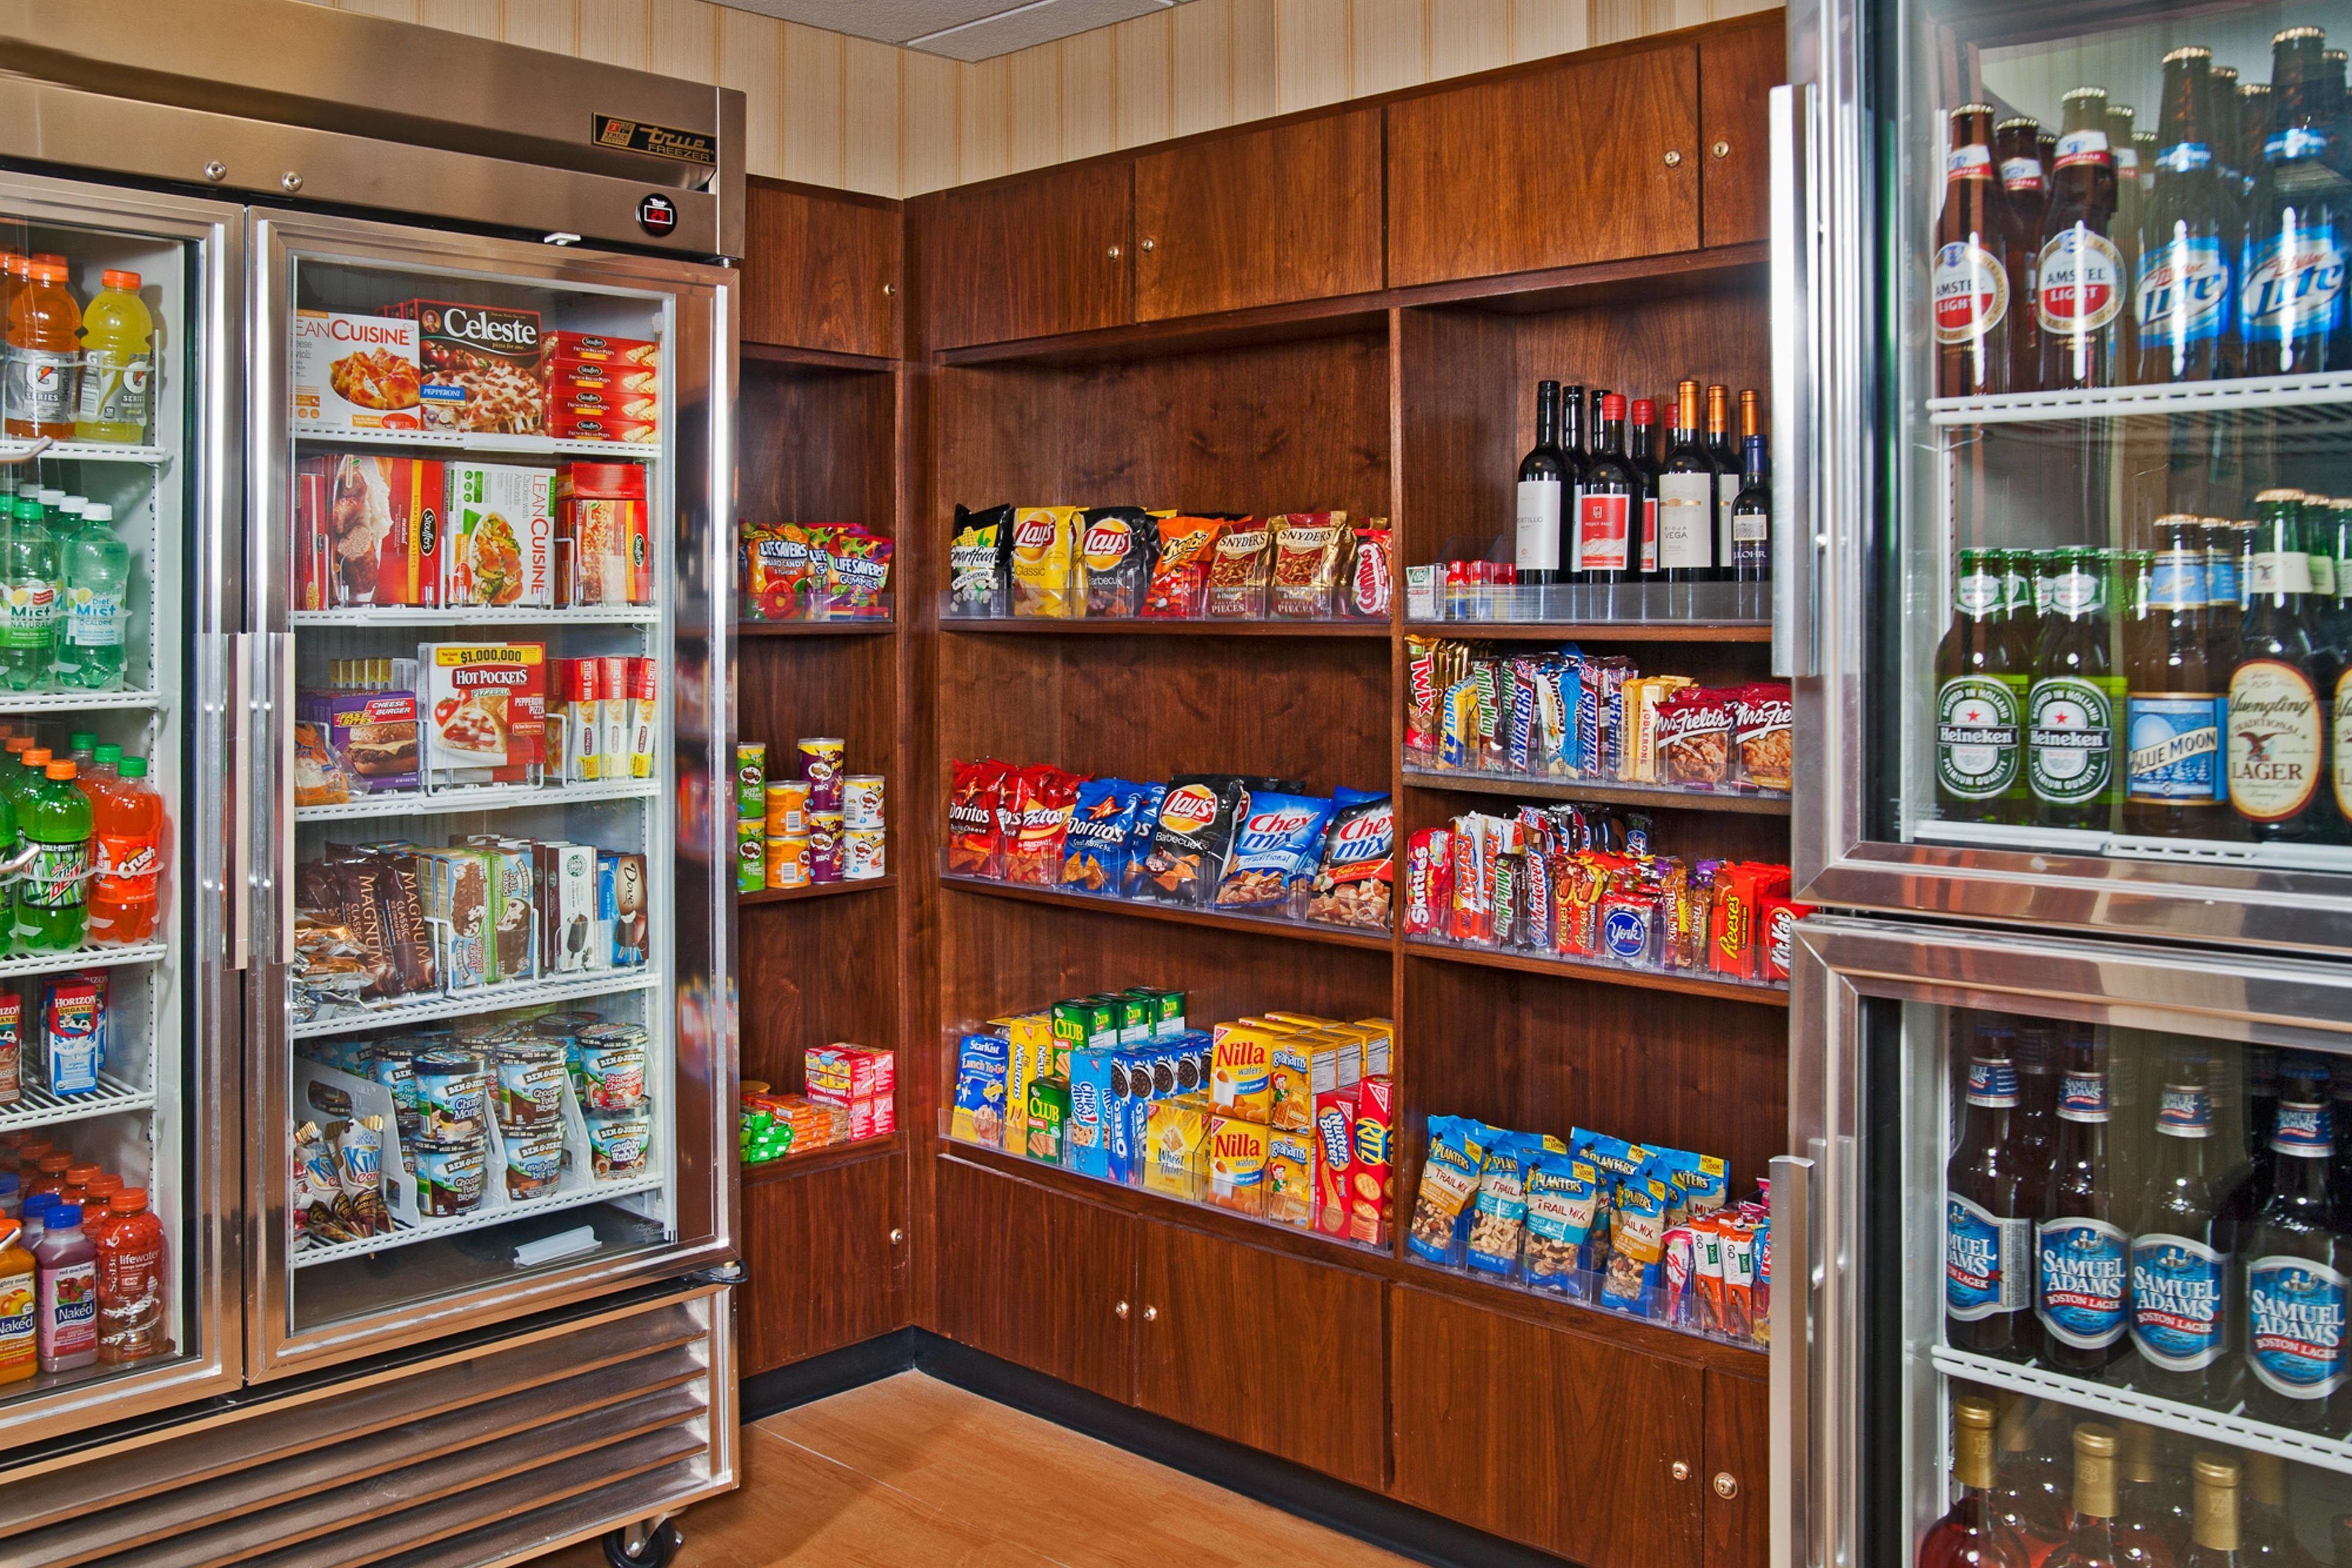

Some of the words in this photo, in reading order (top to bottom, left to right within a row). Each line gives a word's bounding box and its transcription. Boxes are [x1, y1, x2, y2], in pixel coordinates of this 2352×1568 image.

[648, 143, 710, 162] FREEZER
[444, 308, 537, 345] Celeste
[423, 388, 461, 397] PEPPERONI
[532, 475, 547, 517] LEAN
[423, 513, 434, 550] Stouffer's
[1016, 519, 1055, 548] Lay's
[1084, 530, 1131, 555] Lay's
[1219, 533, 1265, 548] SNYDER'S
[531, 518, 549, 595] CUISINE
[840, 576, 878, 590] GUMMIES
[1015, 565, 1046, 576] Classic
[461, 649, 521, 664] $1,000,000
[456, 670, 479, 685] HOT
[480, 670, 527, 684] POCKETS
[1411, 652, 1438, 718] Twix
[1474, 667, 1495, 703] Milky
[375, 707, 410, 716] BURGER
[1966, 688, 1976, 697] IN
[1978, 689, 2009, 719] HOLLAND
[2066, 690, 2100, 722] HOLLAND
[1479, 706, 1498, 737] Way
[1509, 681, 1534, 767] SNICKERS
[1582, 690, 1597, 773] SNICKERS
[1673, 706, 1727, 744] Fields
[2234, 718, 2299, 734] TRADITIONAL
[1640, 709, 1651, 765] TOBLERONE
[1940, 728, 2013, 743] Heineken
[2030, 730, 2103, 746] Heineken
[2169, 731, 2216, 759] MOON
[1943, 758, 1973, 785] PREMIUM
[1975, 760, 2008, 785] QUALITY
[2032, 761, 2062, 789] PREMIUM
[2064, 764, 2098, 789] QUALITY
[2232, 763, 2303, 780] LAGER
[949, 802, 990, 824] Doritos
[1167, 792, 1215, 824] Lay's
[1248, 812, 1320, 833] Chex
[1341, 813, 1393, 840] Chex
[1243, 832, 1294, 851] mix
[1335, 838, 1386, 859] mix
[118, 845, 156, 879] Crush
[1495, 867, 1513, 906] Milky
[1665, 889, 1677, 918] TRAIL
[350, 903, 363, 940] CLASSIC
[358, 873, 384, 969] MAGNUM
[396, 901, 410, 937] CLASSIC
[399, 871, 429, 964] MAGNUM
[1493, 906, 1513, 937] Way
[1719, 894, 1740, 959] Reese's
[1610, 920, 1642, 945] York
[1668, 921, 1678, 941] MIX
[1128, 1008, 1142, 1020] CLUB
[1163, 1001, 1177, 1012] CLUB
[1054, 1018, 1084, 1041] CLUB
[1095, 1014, 1109, 1026] CLUB
[970, 1039, 1000, 1055] StarKist
[1216, 1042, 1265, 1066] Nilla
[1273, 1050, 1306, 1068] grahams
[962, 1058, 984, 1072] Lunch
[1014, 1044, 1027, 1100] Newtons
[1238, 1067, 1262, 1076] wafers
[1030, 1098, 1060, 1122] CLUB
[1080, 1081, 1096, 1115] Chips
[1114, 1100, 1128, 1158] OREO
[1319, 1118, 1339, 1165] Butter
[1330, 1114, 1348, 1162] Nutter
[1357, 1118, 1384, 1164] RITZ
[1158, 1147, 1184, 1163] Wheat
[1215, 1133, 1261, 1158] Nilla
[1271, 1141, 1306, 1159] grahams
[1434, 1144, 1469, 1170] PLANTERS
[343, 1147, 381, 1177] KIN
[1436, 1168, 1456, 1187] TRAIL
[1457, 1180, 1468, 1194] MIX
[1493, 1181, 1514, 1195] TRAIL
[1535, 1173, 1583, 1193] PLANTERS
[1537, 1199, 1567, 1216] TRAIL
[1569, 1207, 1586, 1221] MIX
[1640, 1224, 1653, 1238] MIX
[119, 1249, 159, 1264] lifewater
[2043, 1250, 2127, 1278] SAMUEL
[2047, 1273, 2121, 1297] ADAMS
[2133, 1265, 2221, 1301] SAMUEL
[58, 1304, 93, 1321] Naked
[2136, 1290, 2214, 1321] ADAMS
[2252, 1289, 2345, 1325] SAMUEL
[2255, 1314, 2340, 1347] ADAMS
